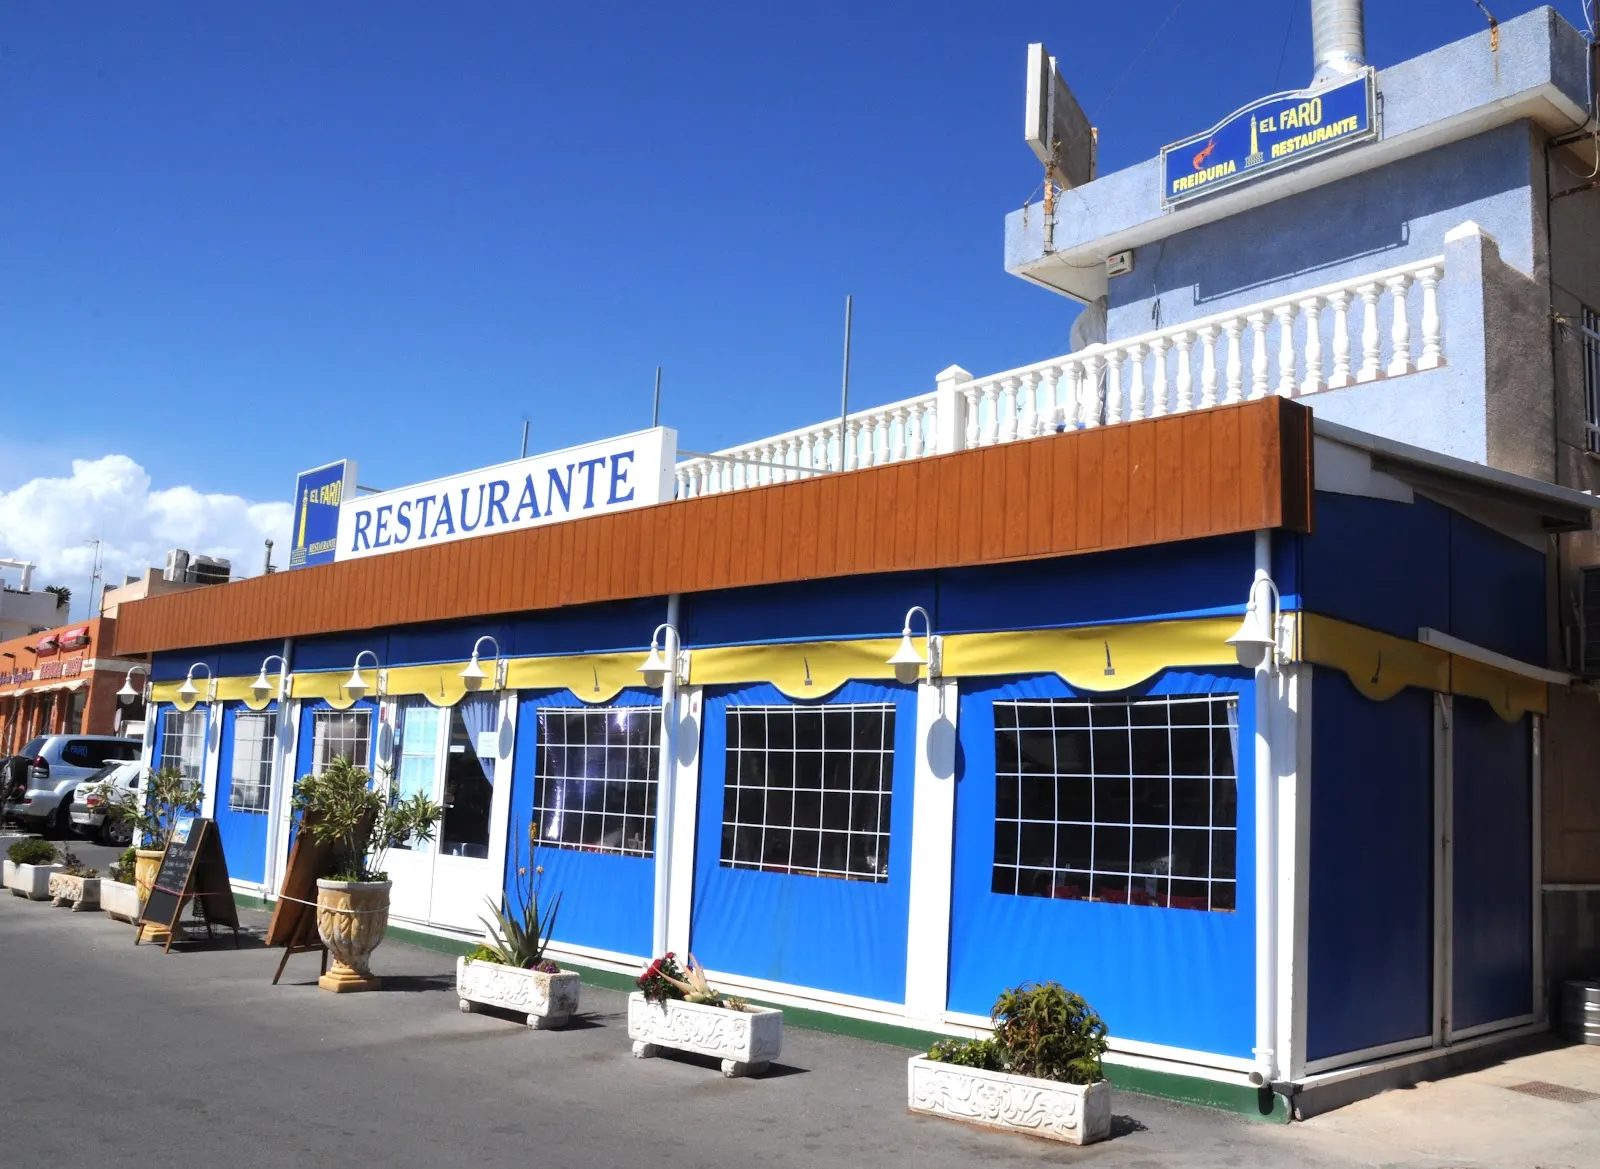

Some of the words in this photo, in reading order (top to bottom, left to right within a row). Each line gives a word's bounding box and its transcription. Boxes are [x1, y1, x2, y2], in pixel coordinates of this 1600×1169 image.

[1260, 116, 1277, 133] EL
[1280, 97, 1322, 130] FARO
[1272, 116, 1358, 158] RESTAURANTE
[1173, 160, 1236, 193] FREIDURIA
[310, 489, 319, 503] EL
[320, 480, 341, 506] FARO
[351, 450, 635, 552] RESTAURANTE
